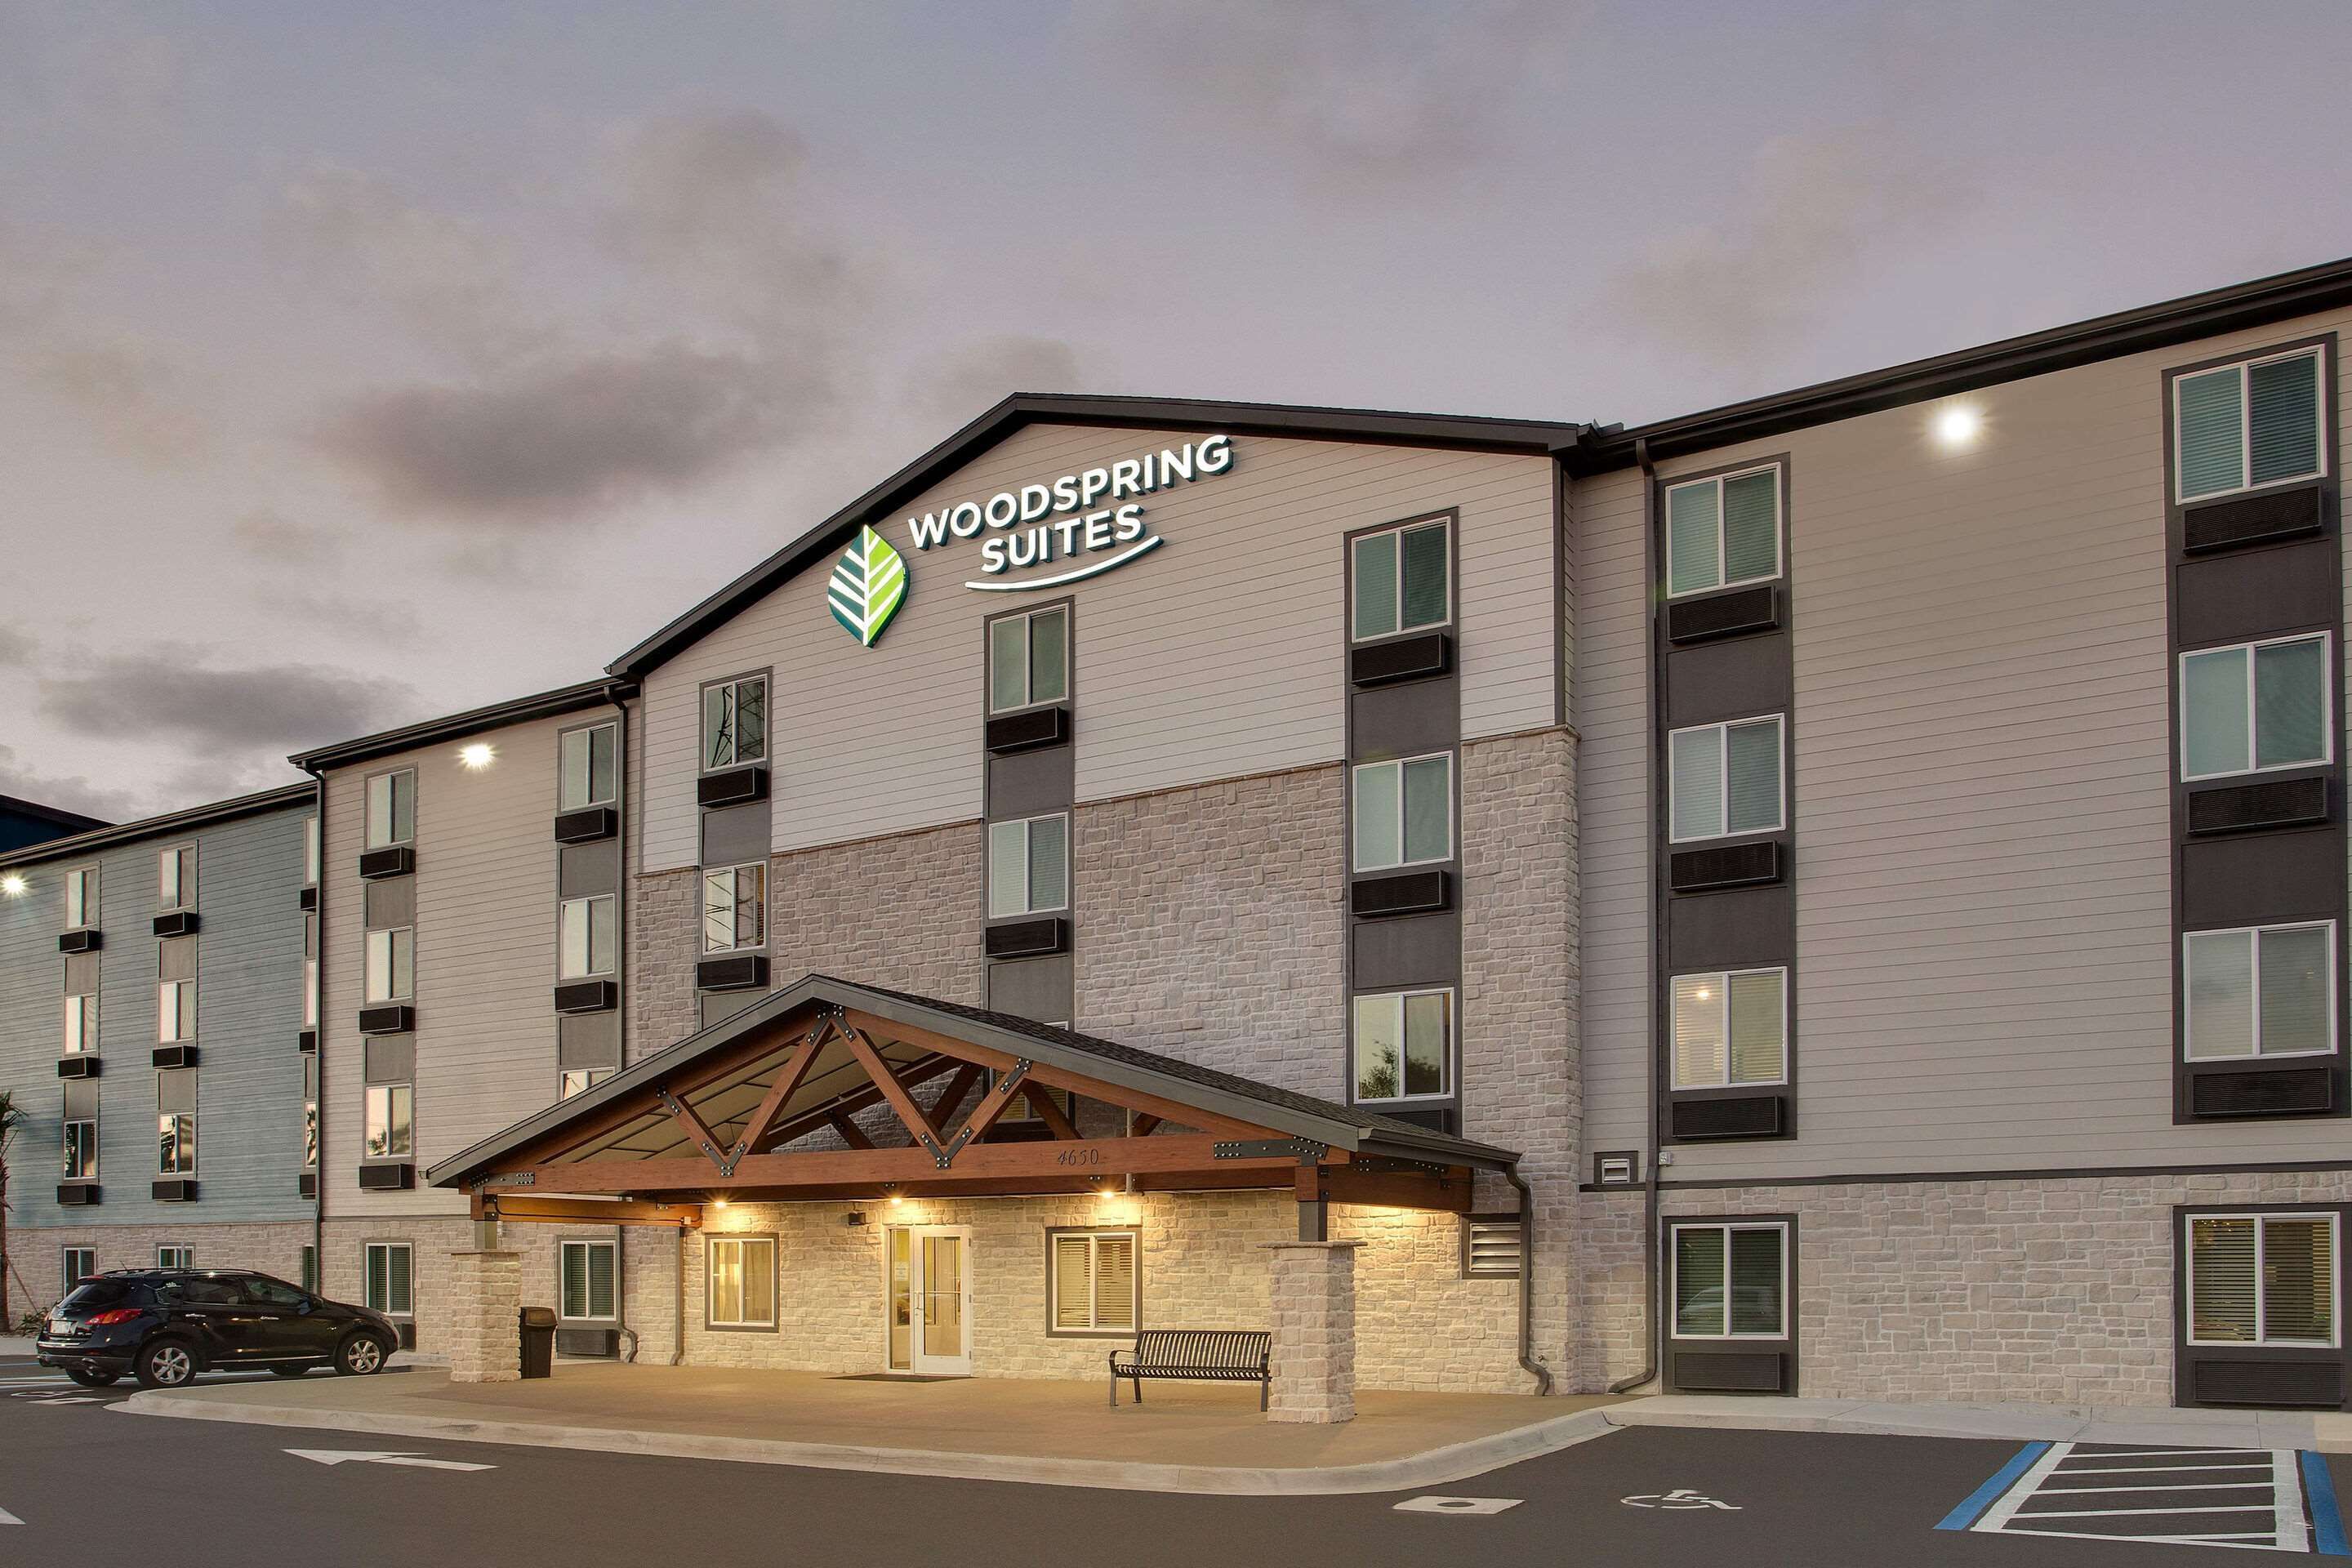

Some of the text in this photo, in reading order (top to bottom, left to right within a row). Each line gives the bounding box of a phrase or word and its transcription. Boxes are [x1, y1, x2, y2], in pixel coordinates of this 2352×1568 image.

[907, 434, 1232, 550] WOODSPRING
[980, 504, 1145, 574] SUITES
[1058, 1148, 1099, 1166] 4650
